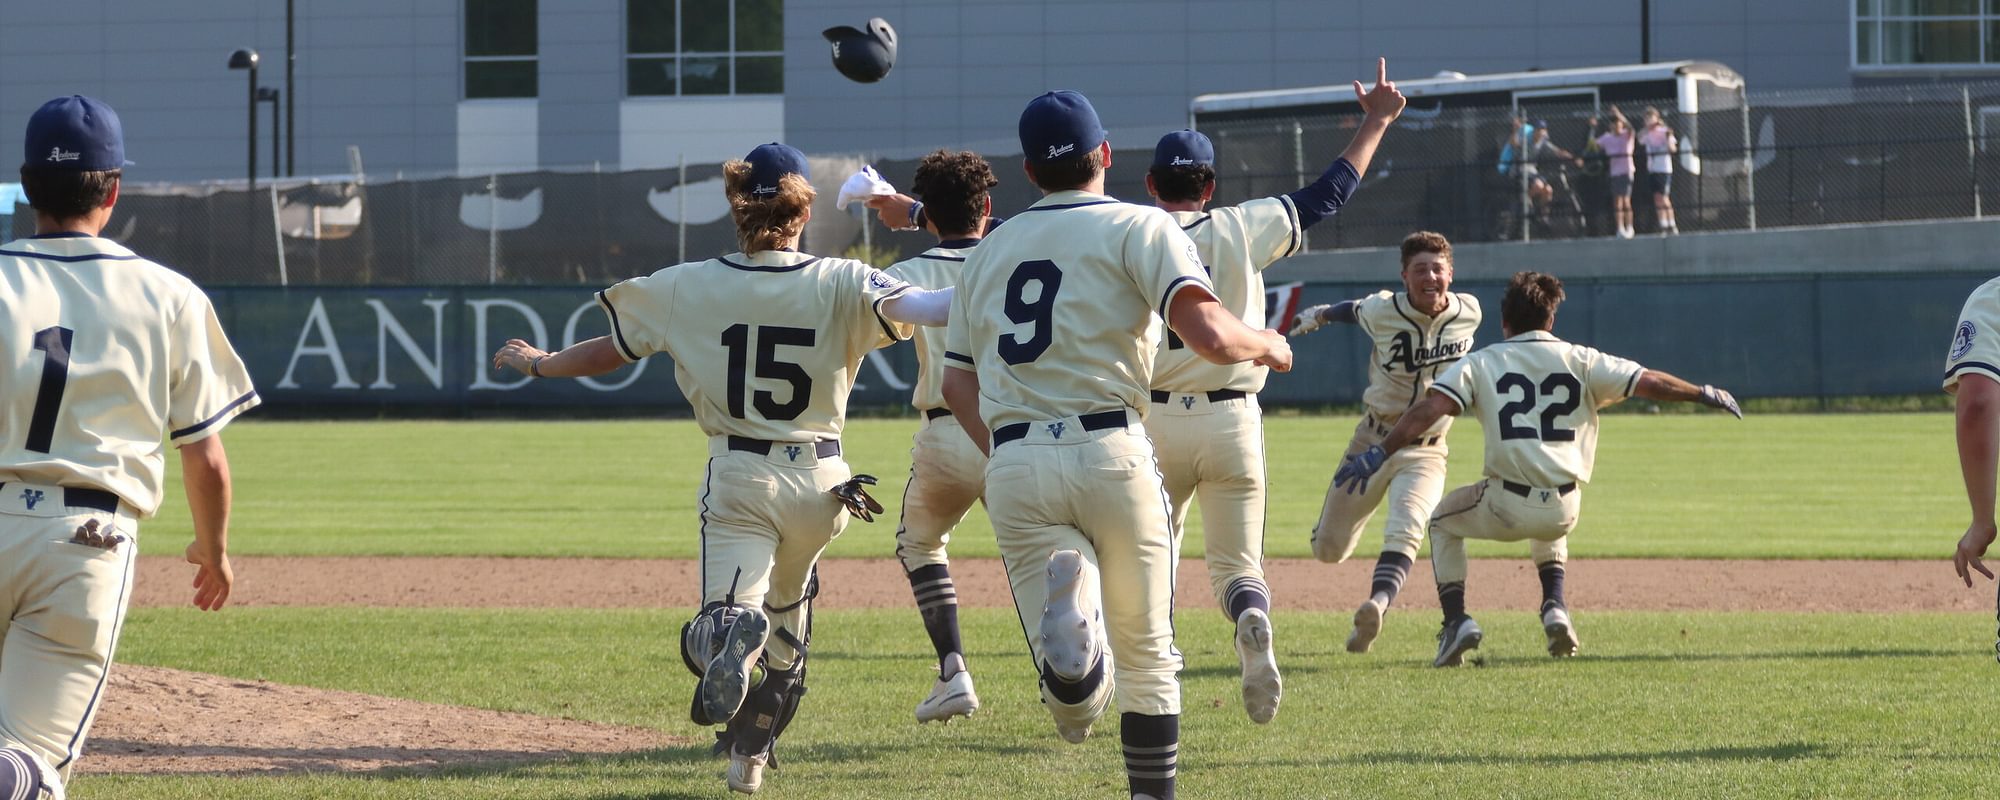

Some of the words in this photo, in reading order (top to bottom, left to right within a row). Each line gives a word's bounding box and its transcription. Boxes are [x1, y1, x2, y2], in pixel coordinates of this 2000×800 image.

[276, 297, 911, 391] ANDO
[998, 259, 1063, 366] 9
[1382, 331, 1468, 373] Andover
[25, 325, 74, 454] 1
[721, 323, 816, 421] 15
[1496, 372, 1581, 441] 22
